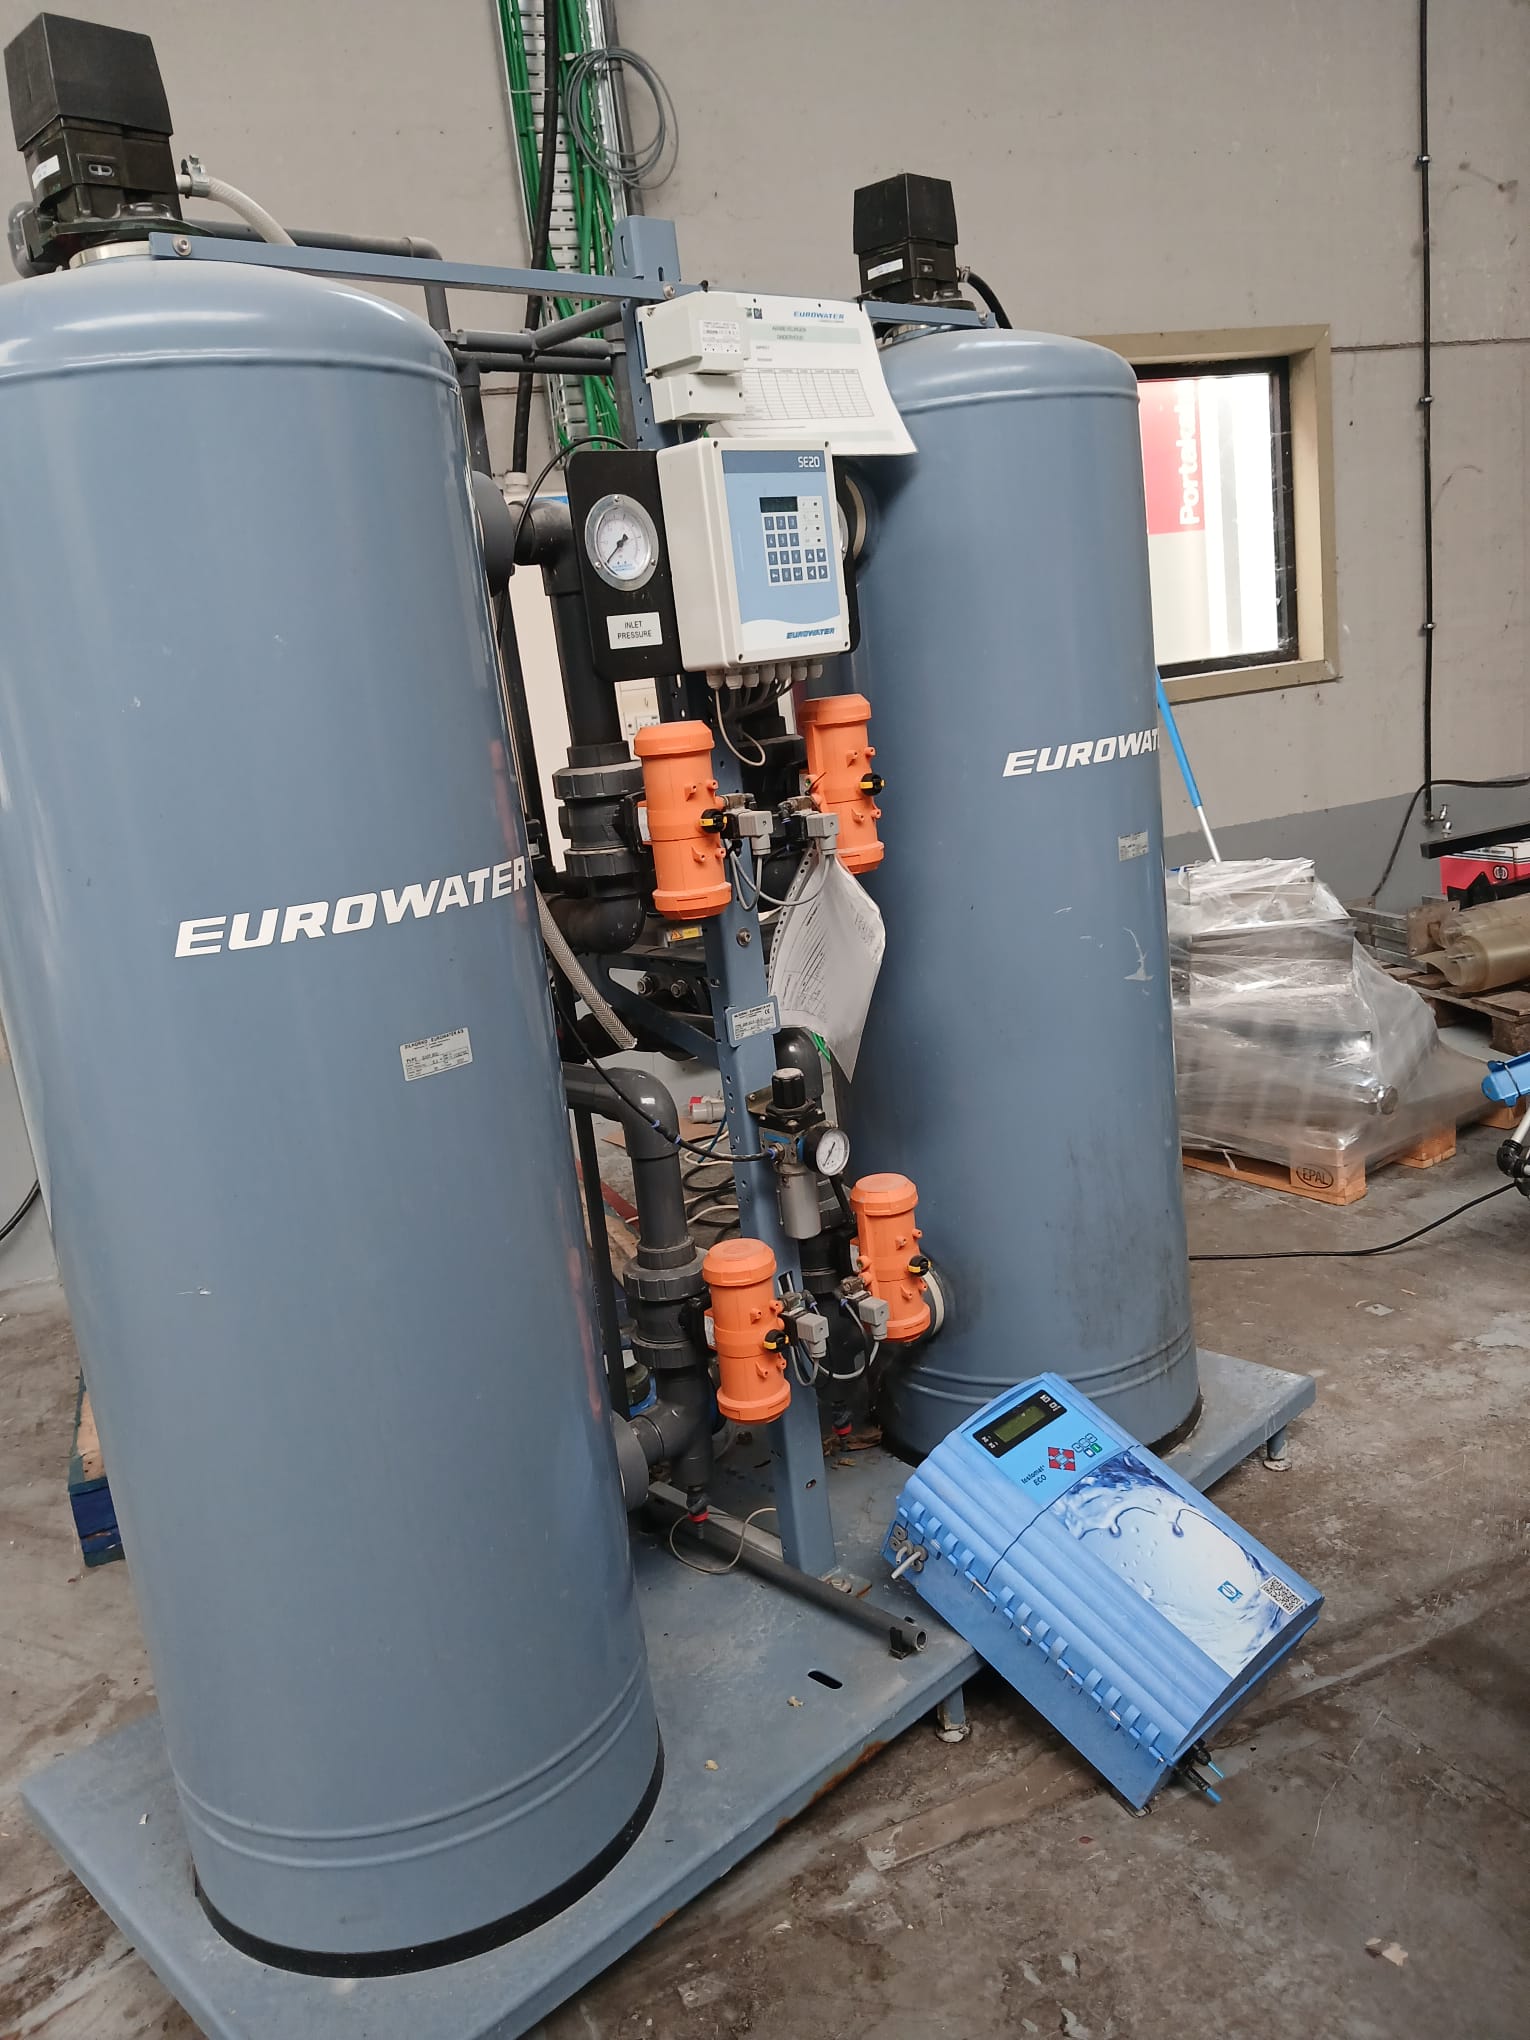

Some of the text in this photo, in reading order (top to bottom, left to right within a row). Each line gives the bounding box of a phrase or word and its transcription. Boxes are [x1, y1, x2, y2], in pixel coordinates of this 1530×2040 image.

[794, 311, 845, 320] EUROWATER
[797, 456, 821, 468] SE20
[624, 620, 642, 629] INLET
[618, 630, 652, 640] PRESSURE
[786, 628, 836, 639] EUROWATER
[1002, 728, 1160, 777] EUROWAT
[174, 855, 527, 959] EUROWATER
[1302, 1167, 1329, 1186] EPAL
[1033, 1474, 1047, 1486] ECO
